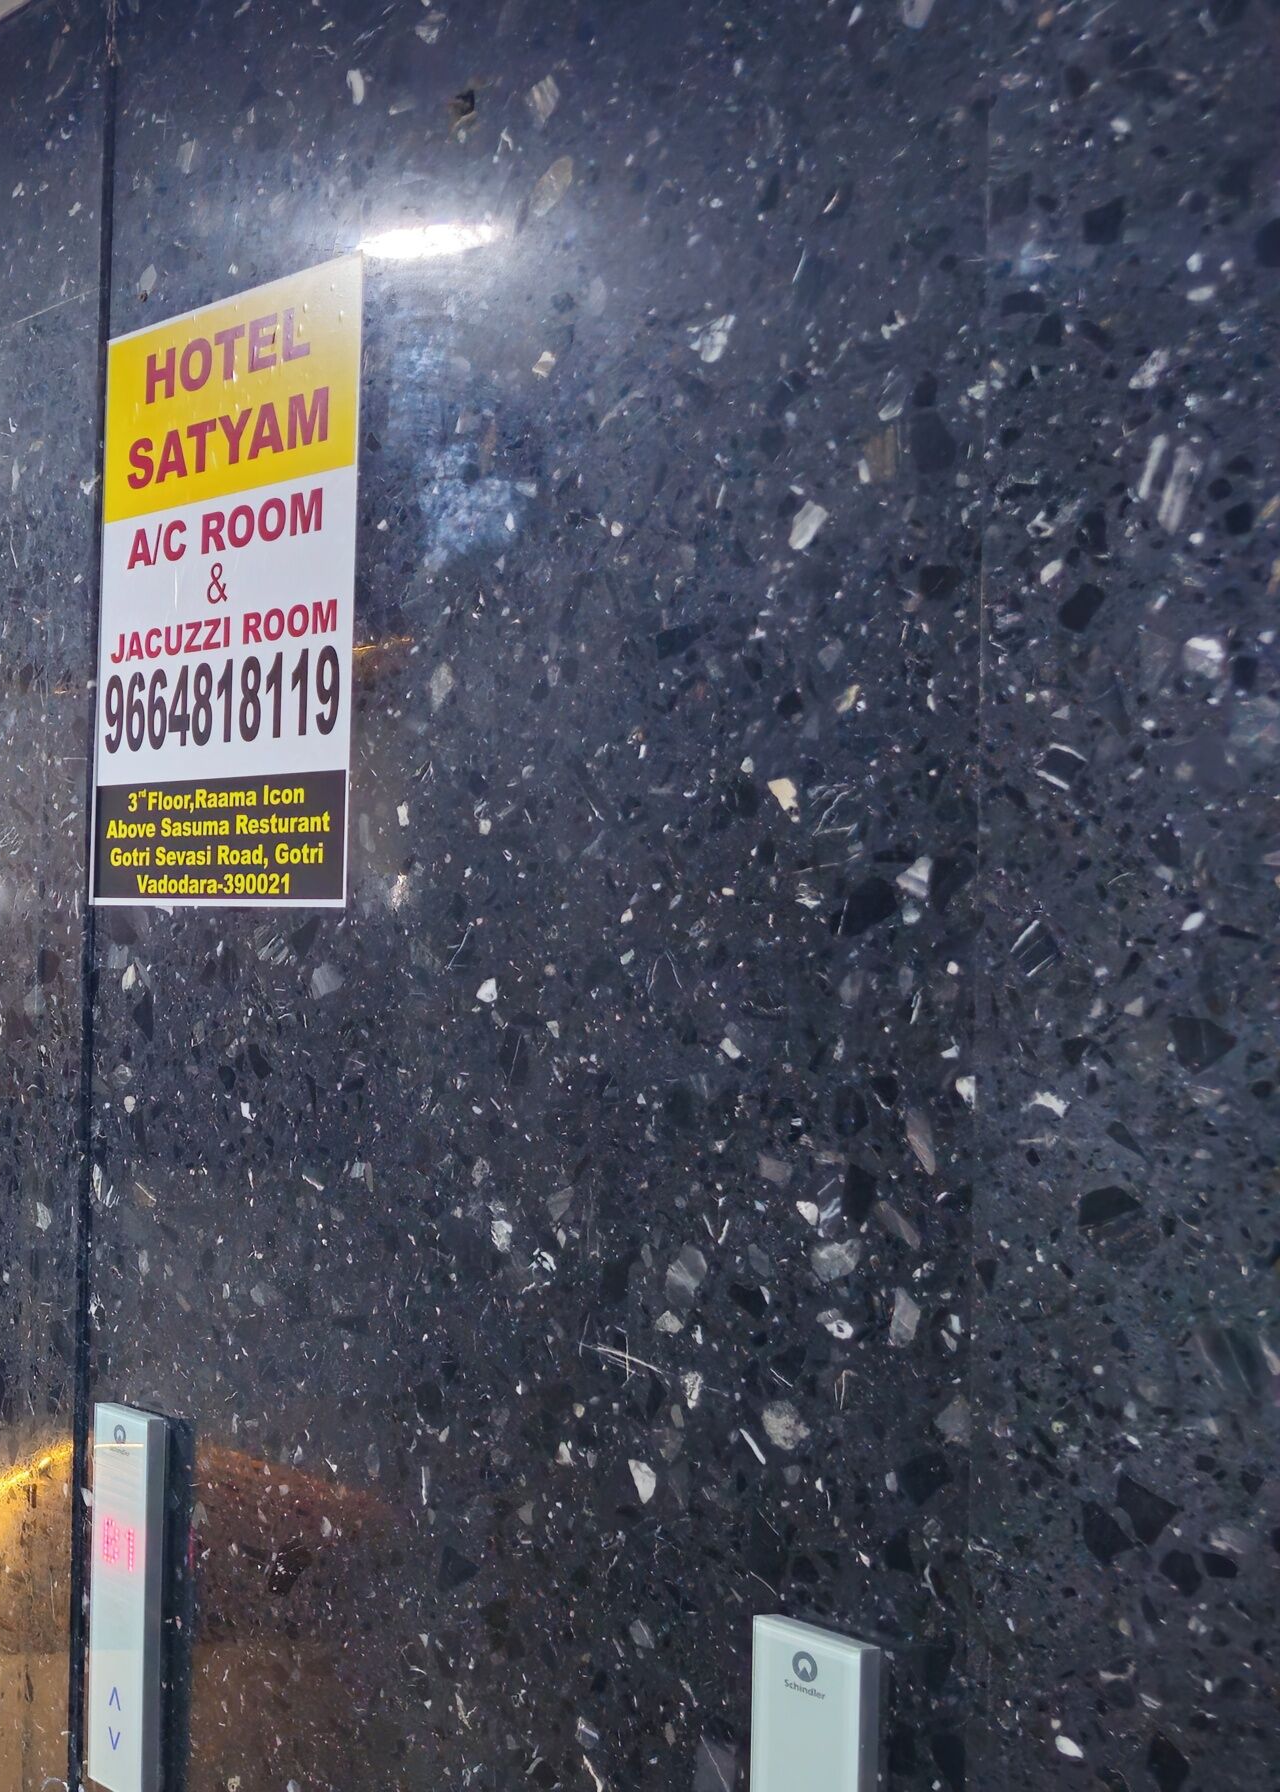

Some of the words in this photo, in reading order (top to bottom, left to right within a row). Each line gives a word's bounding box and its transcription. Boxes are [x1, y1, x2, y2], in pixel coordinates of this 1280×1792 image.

[145, 307, 311, 405] HOTEL
[127, 386, 329, 490] SATYAM
[127, 519, 187, 570] A/C
[201, 487, 323, 555] ROOM
[206, 562, 228, 605] &
[110, 616, 231, 664] JACUZZI
[242, 598, 338, 645] ROOM
[105, 645, 340, 754] 9664818119
[263, 784, 305, 806] Icon
[106, 819, 156, 839] Above
[161, 815, 230, 837] Sasuma
[235, 810, 330, 836] Resturant
[110, 847, 151, 868] Gotri
[155, 845, 212, 866] Sevasi
[217, 843, 269, 869] Road,
[275, 842, 324, 865] Gotri
[136, 872, 291, 895] Vadodara-390021
[784, 1679, 826, 1700] Schindler
